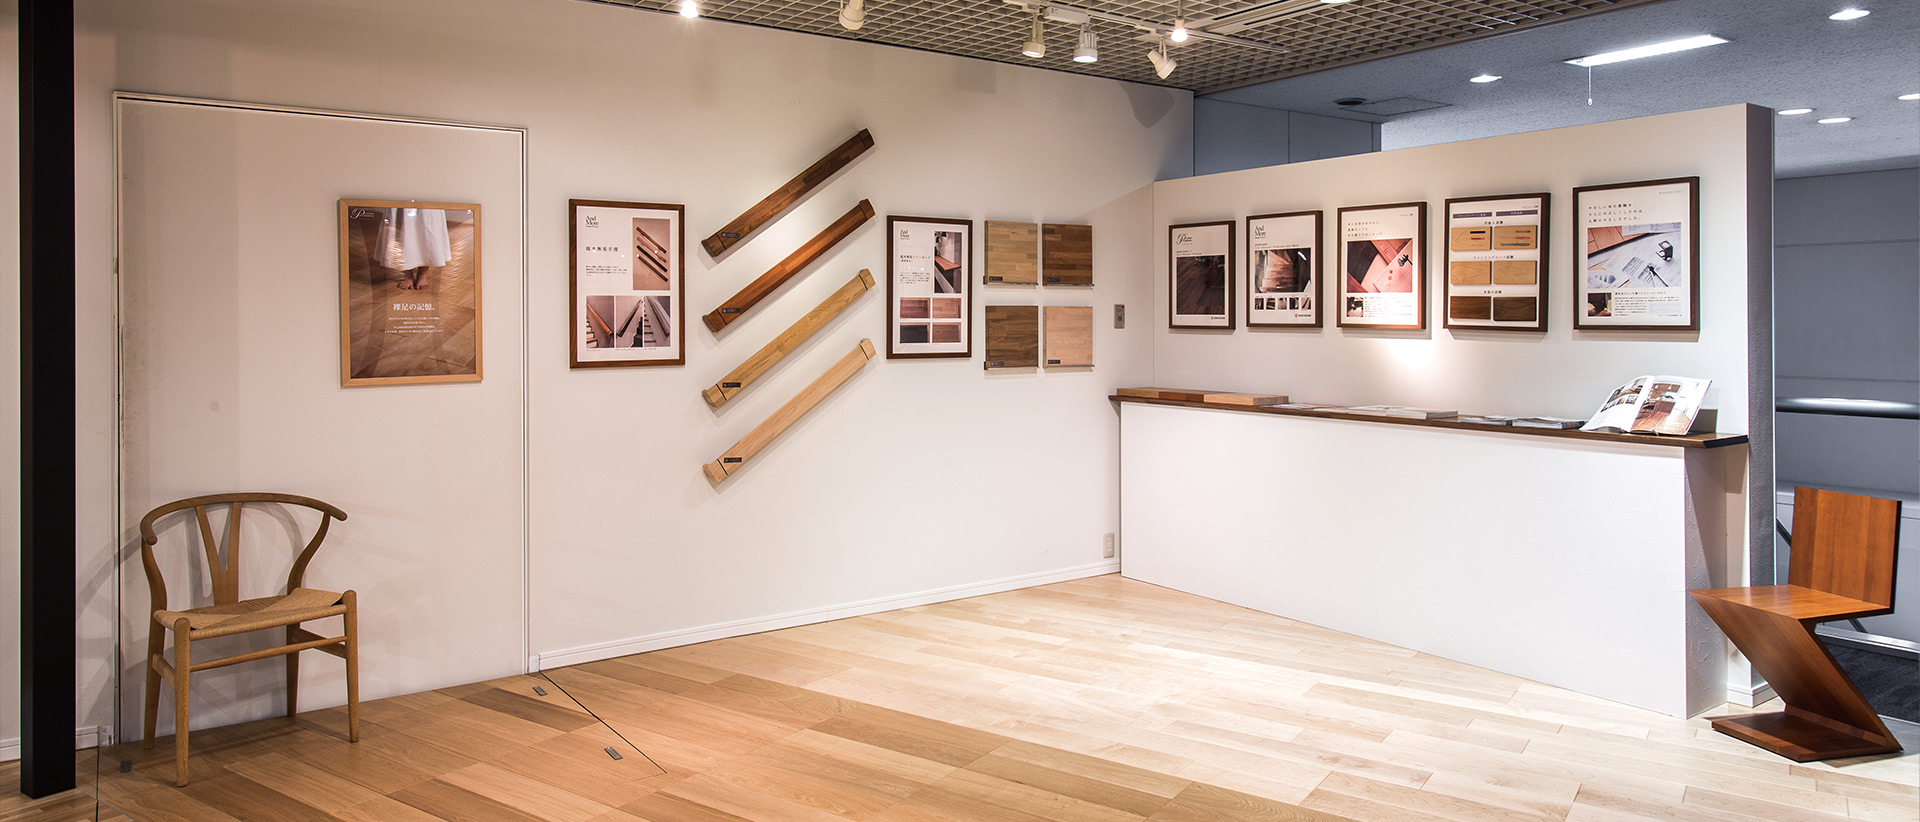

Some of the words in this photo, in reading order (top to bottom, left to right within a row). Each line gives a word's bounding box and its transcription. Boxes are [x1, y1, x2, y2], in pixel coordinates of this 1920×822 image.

[392, 303, 436, 311] 裸足の記憶。
